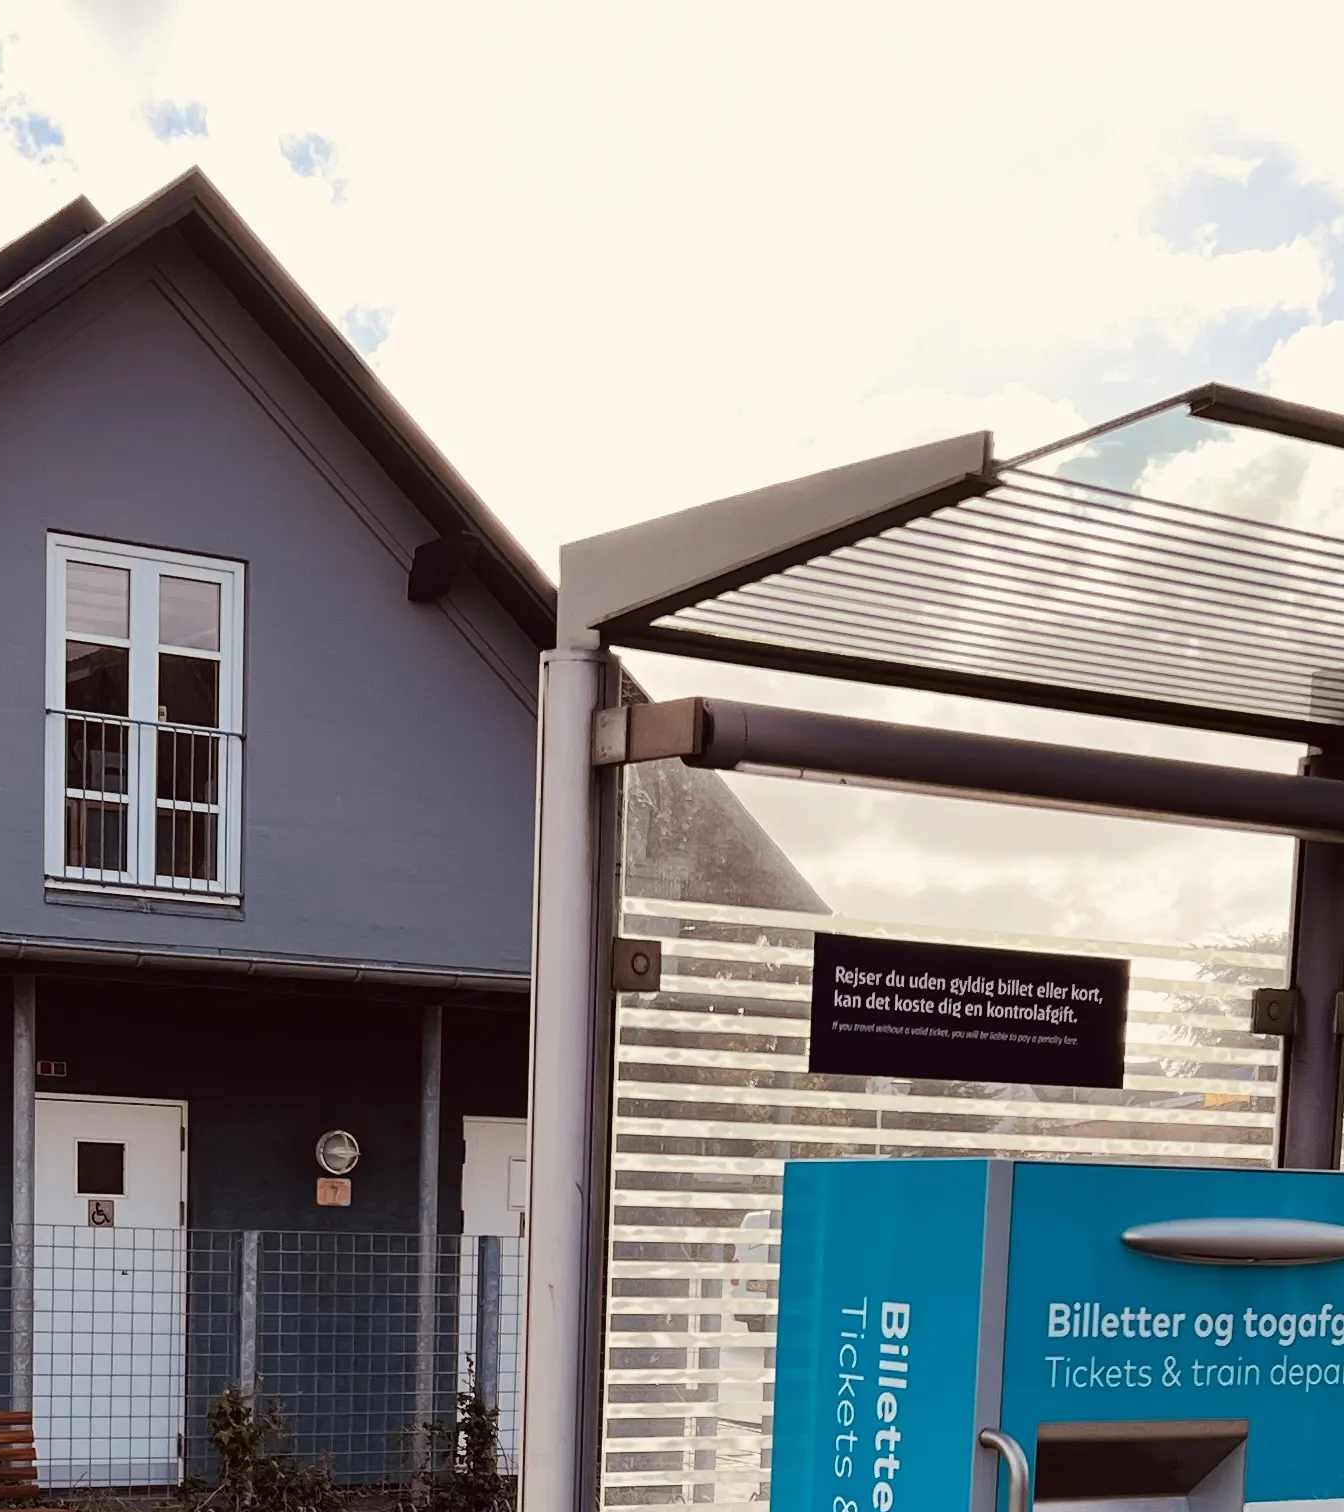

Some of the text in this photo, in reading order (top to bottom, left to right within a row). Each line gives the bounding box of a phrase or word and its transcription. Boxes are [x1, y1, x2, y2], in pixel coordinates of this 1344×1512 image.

[836, 966, 1103, 1004] Rejser du uden gyldig billet eller kort,
[834, 990, 1078, 1024] kan det koste dig en kontrolafgift.
[839, 1024, 853, 1032] you
[876, 1024, 903, 1034] without
[952, 1031, 965, 1039] you
[980, 1030, 988, 1039] be
[1017, 1035, 1031, 1044] pay
[1048, 1302, 1185, 1338] Billetter
[1194, 1312, 1233, 1346] og
[834, 1296, 868, 1478] Tickets
[1045, 1356, 1152, 1388] Tickets
[1162, 1356, 1182, 1387] &
[1191, 1356, 1259, 1387] train
